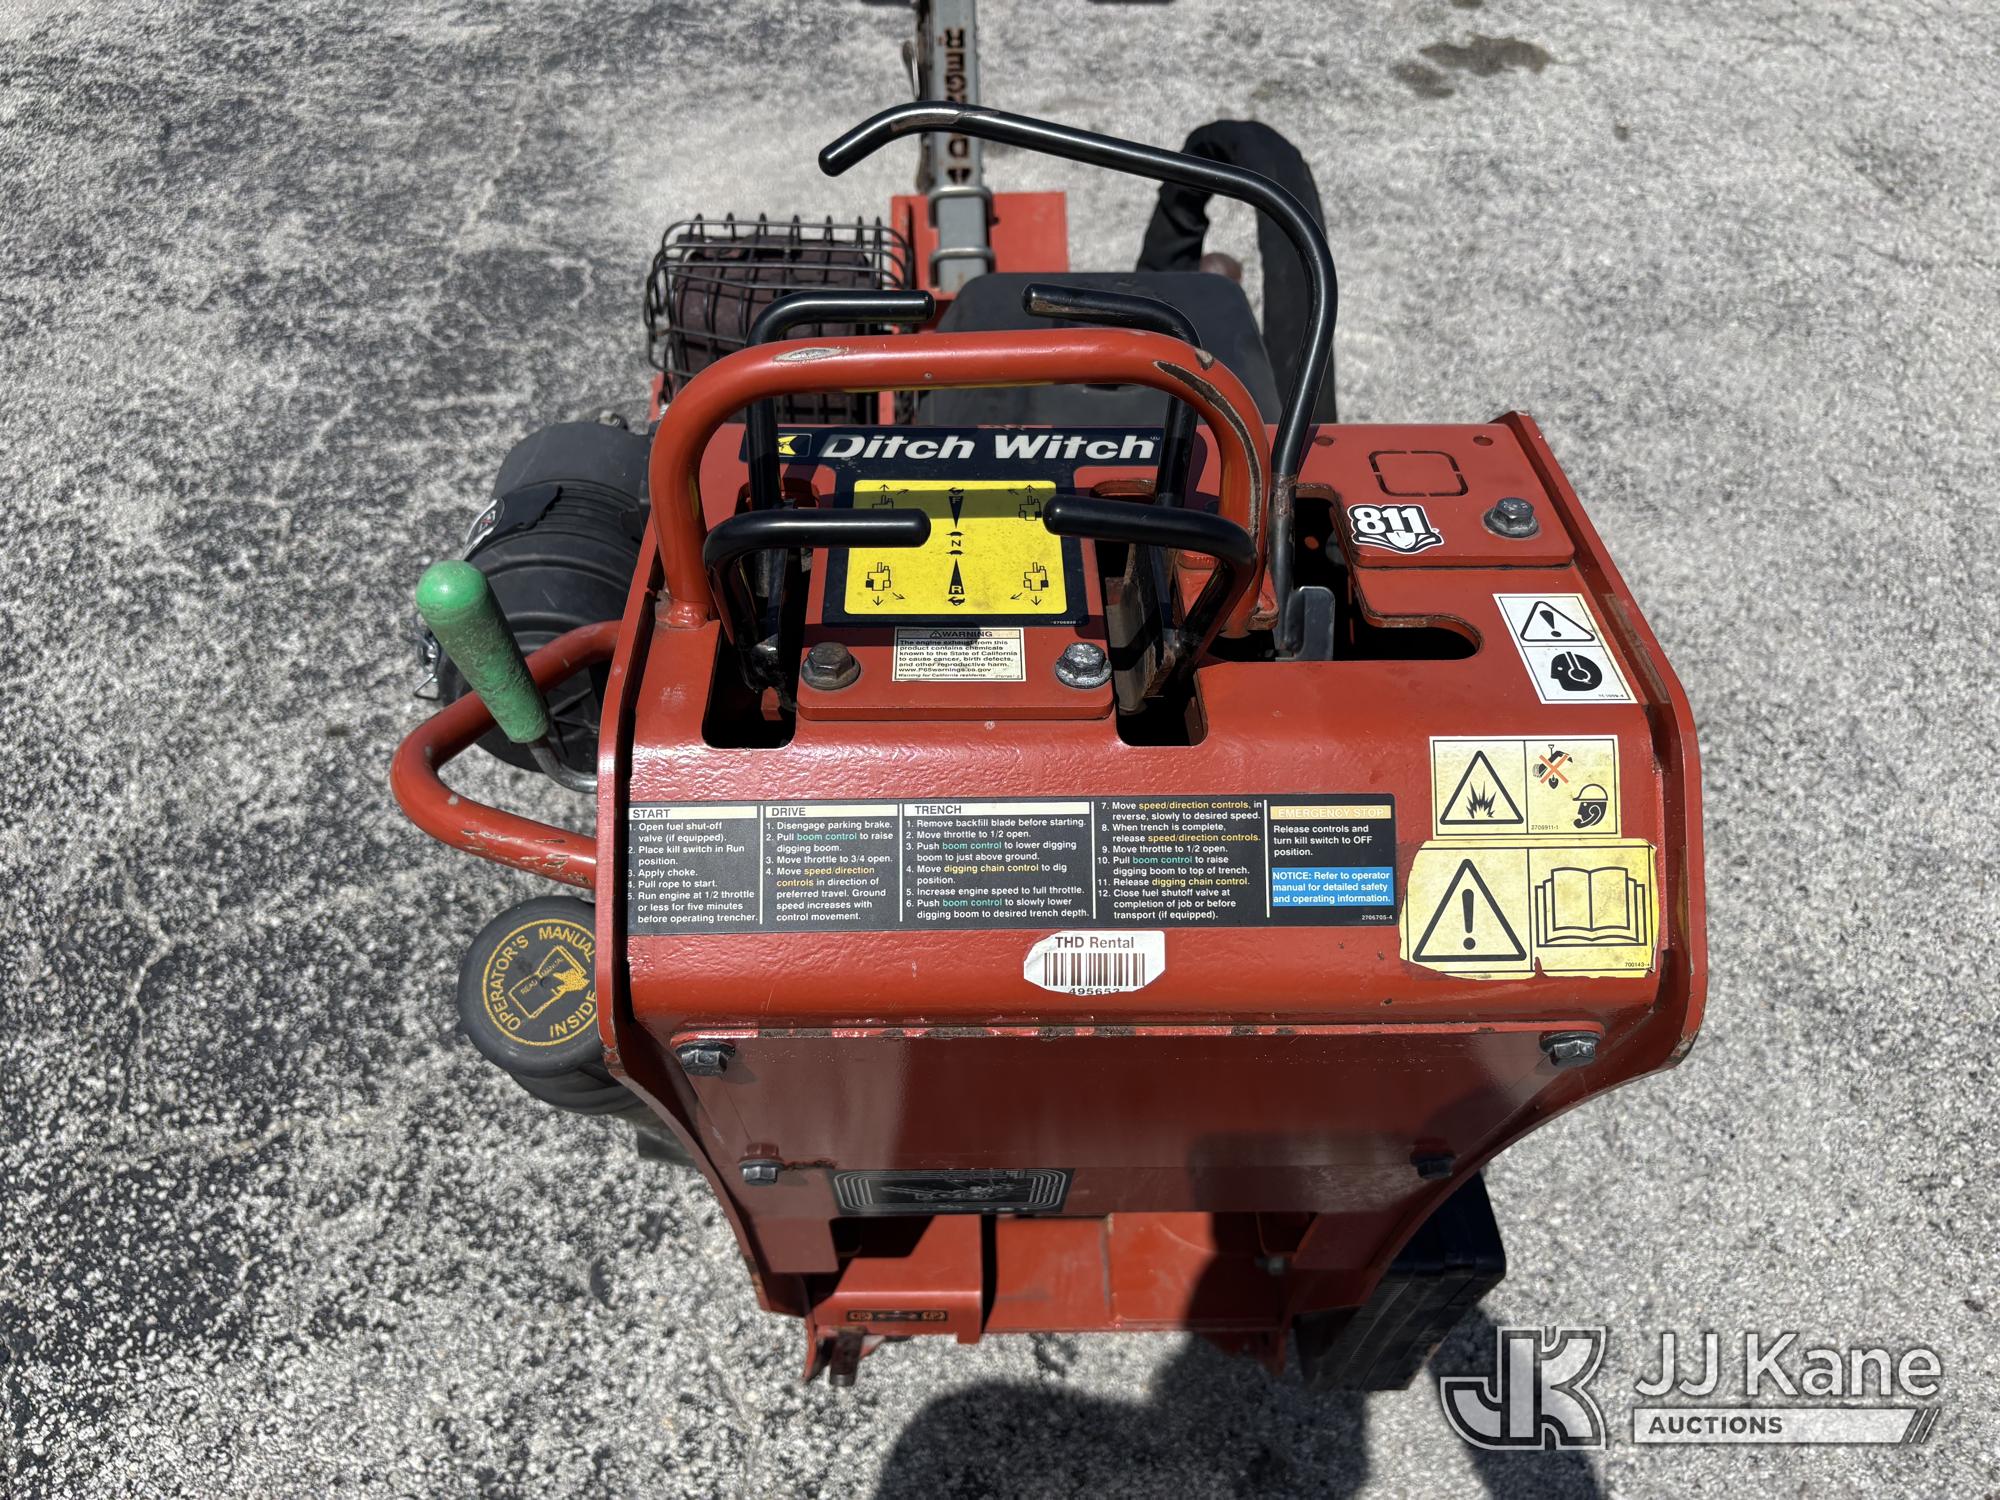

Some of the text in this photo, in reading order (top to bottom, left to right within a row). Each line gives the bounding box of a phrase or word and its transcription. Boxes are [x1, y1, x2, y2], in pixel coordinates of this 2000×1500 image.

[819, 435, 1155, 459] Ditch Witch
[1354, 507, 1426, 534] 811
[951, 585, 962, 593] R
[633, 808, 671, 819] START
[771, 807, 806, 817] DRIVE
[914, 804, 962, 815] TRENCH
[1278, 807, 1384, 818] EMERGENCY STOP
[1112, 813, 1148, 821] reverse,
[1151, 812, 1180, 822] slowly
[1193, 811, 1227, 819] desired
[1230, 811, 1260, 820] speed.
[638, 821, 722, 832] Open fuel shut-off
[776, 820, 825, 831] Disengage
[827, 820, 861, 830] parking
[864, 820, 892, 828] brake.
[916, 819, 953, 827] Remove
[956, 818, 988, 826] backfill
[990, 818, 1015, 826] blade
[1018, 817, 1047, 826] before
[1049, 818, 1087, 828] starting.
[1273, 824, 1368, 833] Release controls and
[638, 833, 726, 843] valve (if equipped).
[1112, 833, 1260, 843] release speed/direction controls.
[1273, 835, 1372, 844] turn kill switch to OFF
[638, 845, 664, 854] Place
[666, 845, 680, 853] kill
[682, 844, 712, 853] switch
[726, 843, 744, 852] Run
[776, 843, 842, 854] digging boom.
[1273, 847, 1312, 858] position.
[638, 856, 678, 867] position.
[916, 852, 1039, 862] boom to just above ground.
[637, 867, 698, 878] Apply choke.
[1272, 871, 1310, 880] NOTICE:
[1314, 871, 1338, 879] Refer
[1351, 872, 1389, 880] operator
[638, 879, 717, 889] Pull rope to start.
[776, 878, 814, 887] controls
[827, 877, 867, 886] direction
[869, 877, 878, 885] of
[1322, 882, 1358, 890] detailed
[1360, 882, 1387, 892] safety
[638, 889, 754, 901] Run engine at 1/2 throttle
[1292, 894, 1334, 904] operating
[1337, 894, 1392, 902] information.
[650, 903, 669, 911] less
[671, 902, 684, 910] for
[687, 902, 703, 910] five
[706, 902, 743, 910] minutes
[637, 912, 758, 924] before operating trencher.
[776, 912, 860, 921] control movement.
[916, 910, 951, 920] digging
[953, 909, 979, 918] boom
[993, 909, 1026, 917] desired
[1029, 908, 1058, 917] trench
[1060, 908, 1088, 918] depth.
[1113, 910, 1218, 920] transport (if equipped).
[1055, 936, 1135, 948] THD Rental
[491, 926, 597, 1038] OPERATOR'S MANUAL INSIDE
